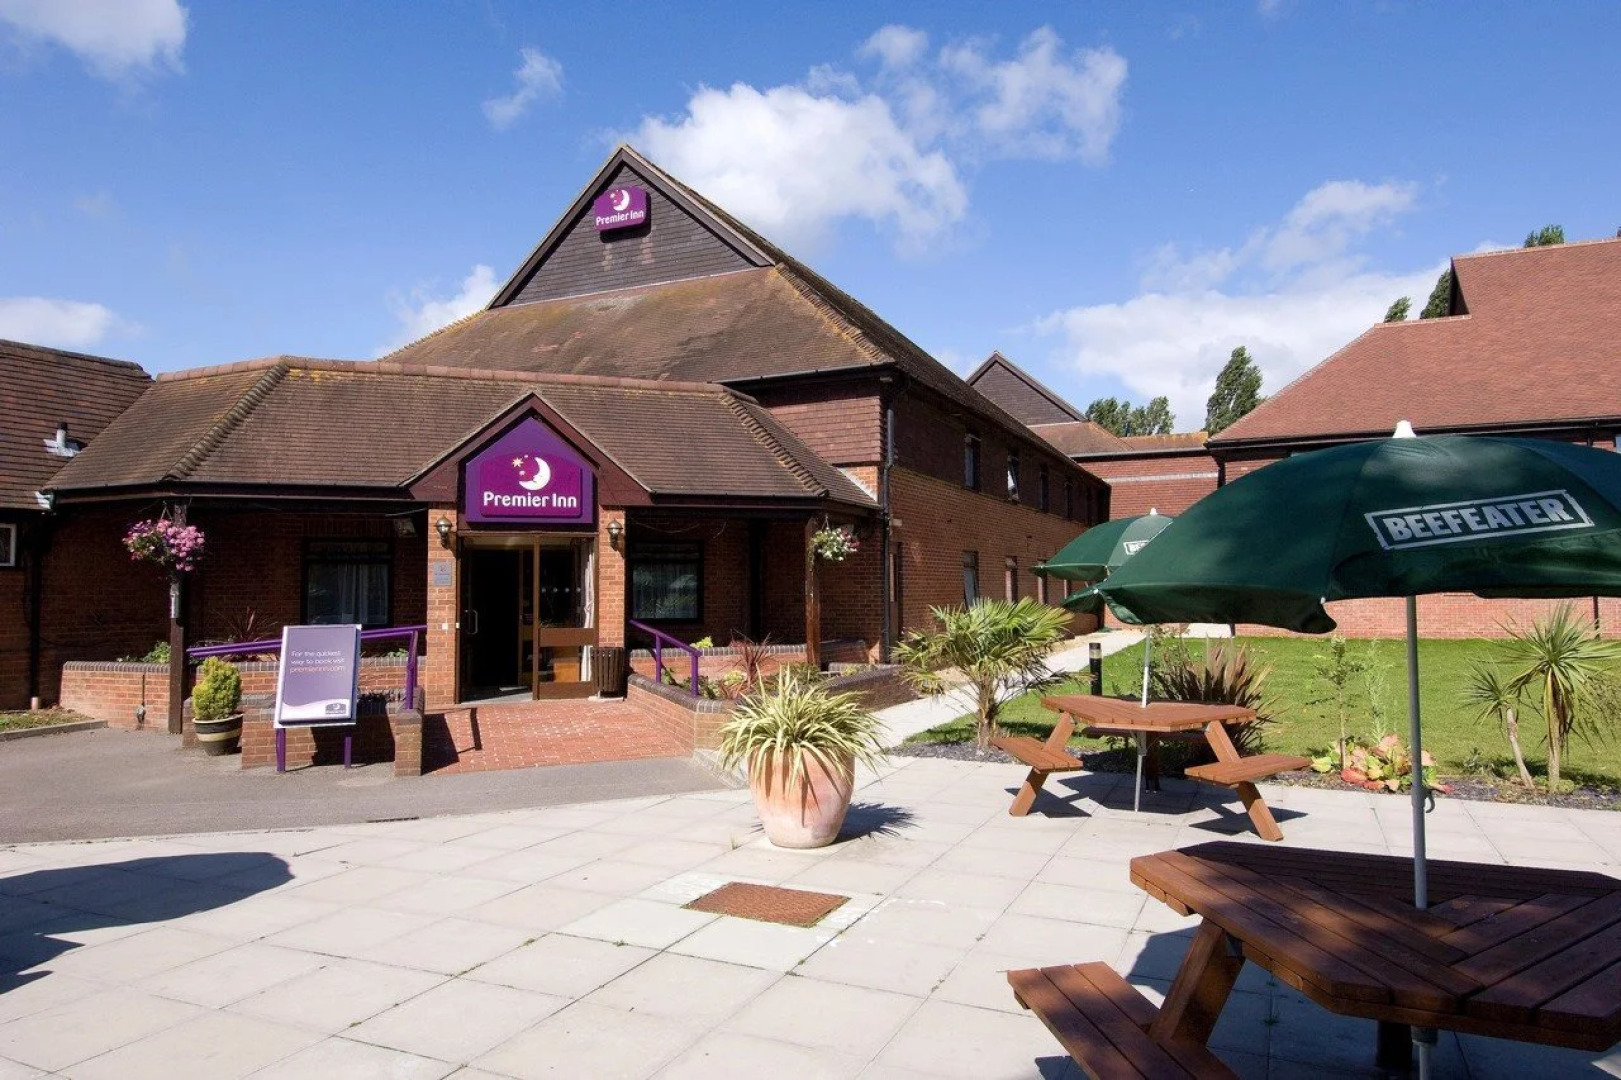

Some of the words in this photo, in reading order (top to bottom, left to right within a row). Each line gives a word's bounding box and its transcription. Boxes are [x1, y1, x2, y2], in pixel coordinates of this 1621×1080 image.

[596, 212, 630, 226] Premier
[630, 210, 644, 220] Inn
[483, 491, 549, 507] Premier
[551, 493, 577, 508] Inn
[1382, 499, 1574, 542] BEEFEATER
[316, 650, 341, 658] quickest
